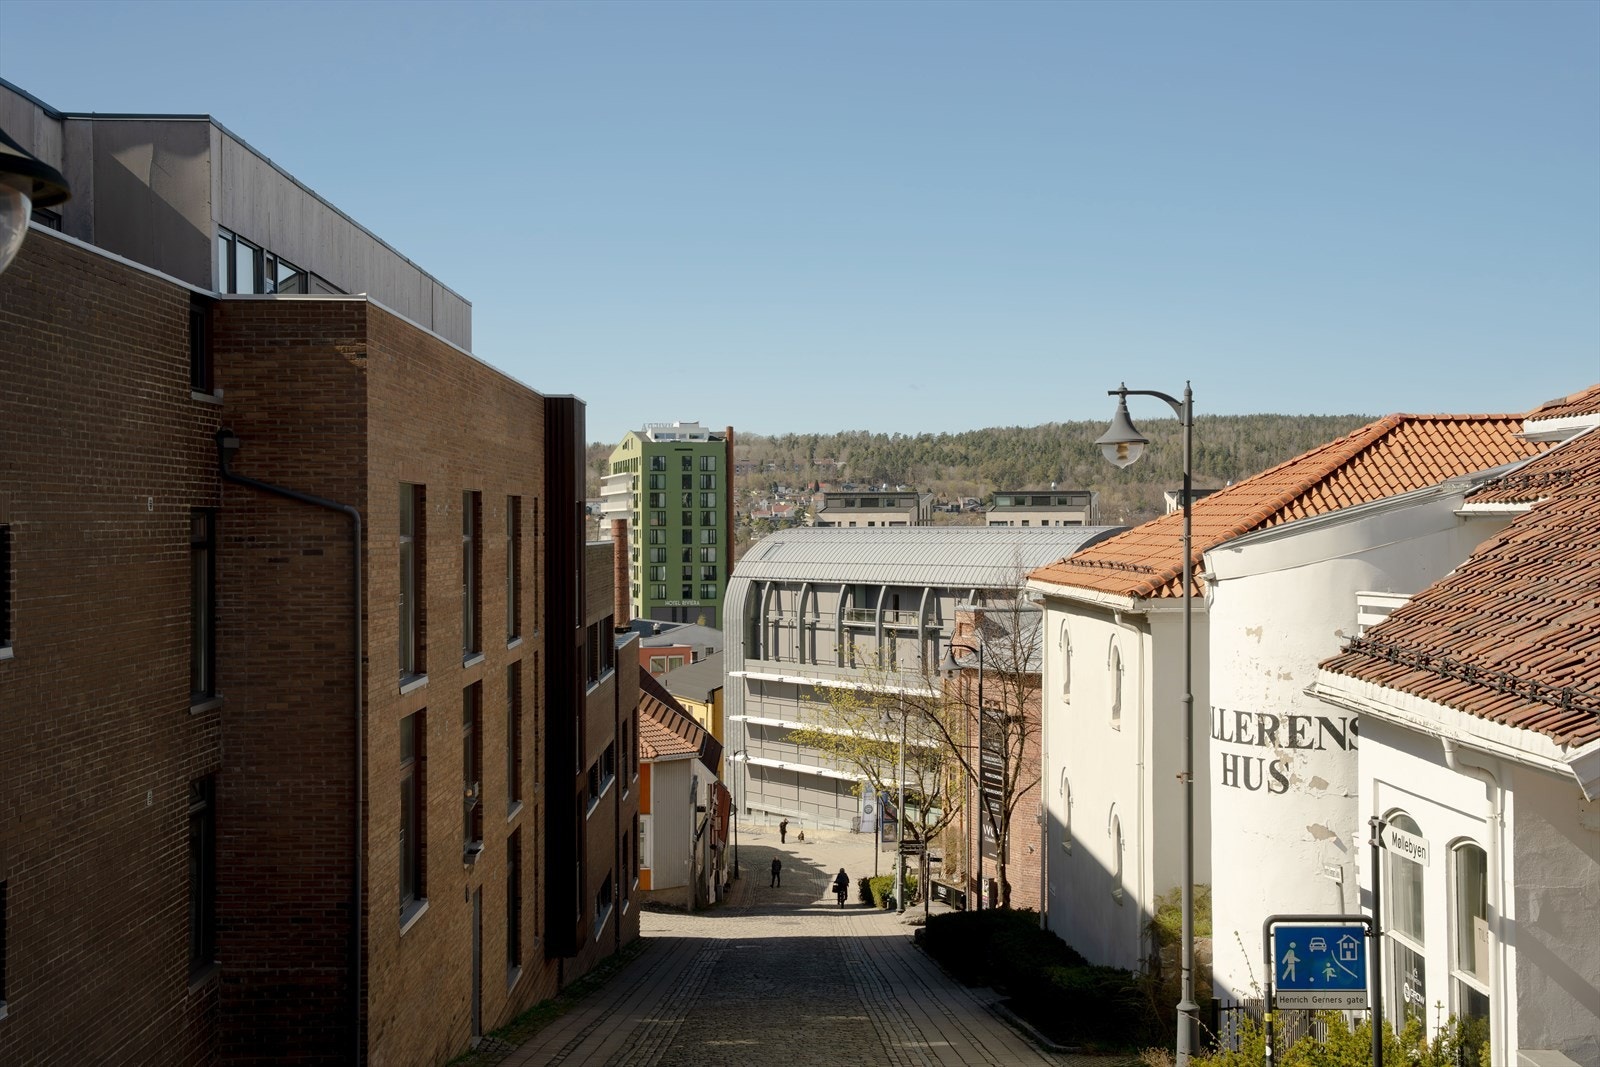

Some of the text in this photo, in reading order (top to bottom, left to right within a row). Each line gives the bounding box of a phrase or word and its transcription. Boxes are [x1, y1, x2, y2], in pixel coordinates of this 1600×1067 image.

[1210, 706, 1359, 751] LLERENS
[1221, 752, 1290, 795] HUS
[1391, 830, 1427, 860] Møllebyen
[1279, 995, 1364, 1006] Henrich Gerners gate
